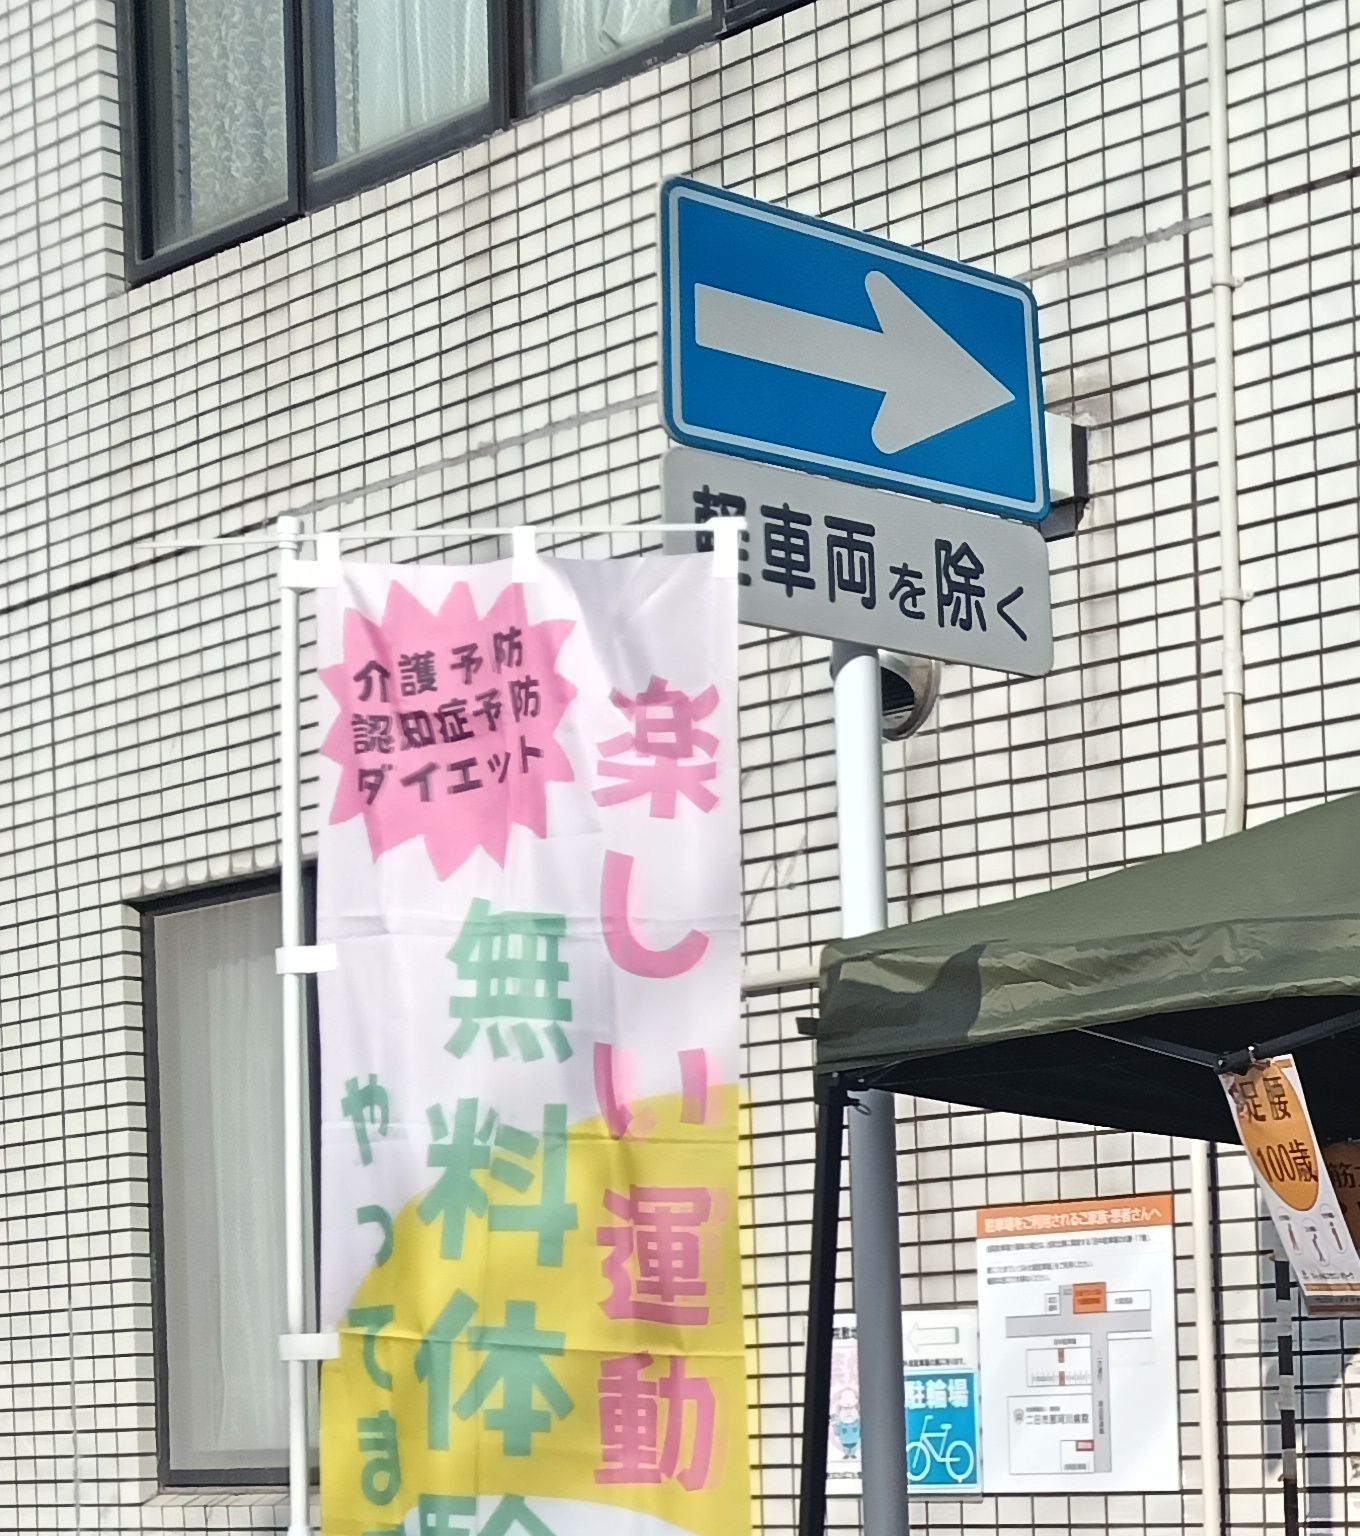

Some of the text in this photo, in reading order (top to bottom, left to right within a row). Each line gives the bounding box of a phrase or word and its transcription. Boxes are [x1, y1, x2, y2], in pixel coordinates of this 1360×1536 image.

[352, 626, 524, 703] 介護予防
[351, 674, 542, 755] 認知症予防
[357, 735, 545, 806] ダイエット
[591, 675, 721, 1493] 楽しい運動
[1237, 1075, 1292, 1123] 足腰
[1256, 1138, 1319, 1184] 100歳
